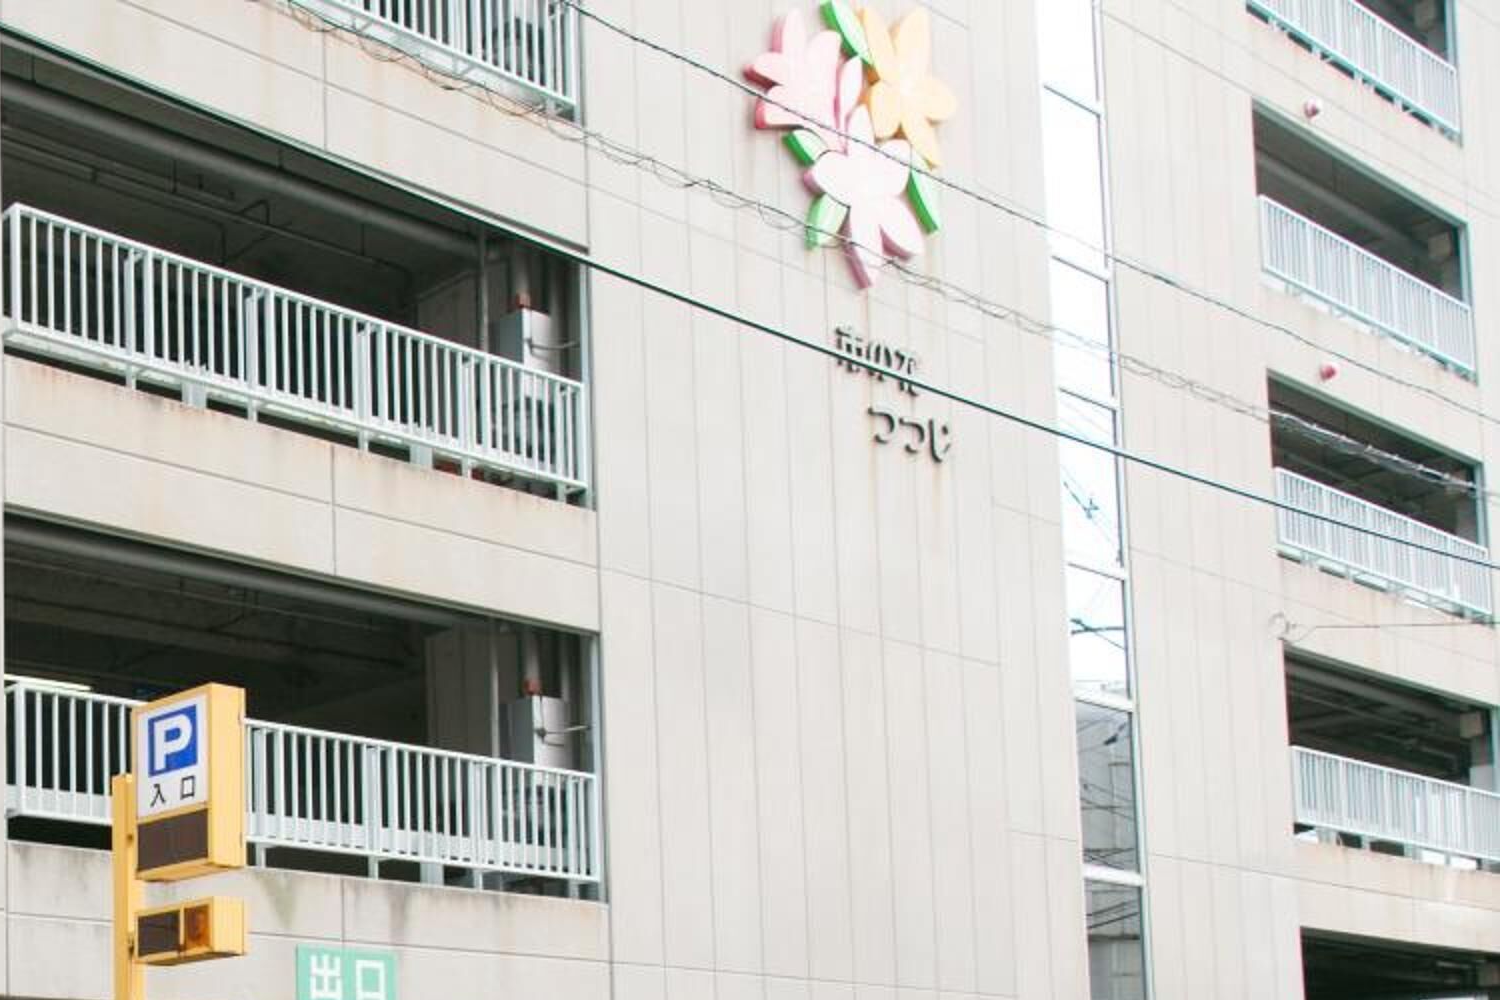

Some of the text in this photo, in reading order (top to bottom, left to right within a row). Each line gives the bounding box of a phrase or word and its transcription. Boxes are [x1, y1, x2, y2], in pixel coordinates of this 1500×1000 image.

[866, 406, 951, 464] つつじ
[153, 714, 194, 771] P
[149, 775, 197, 808] 入口
